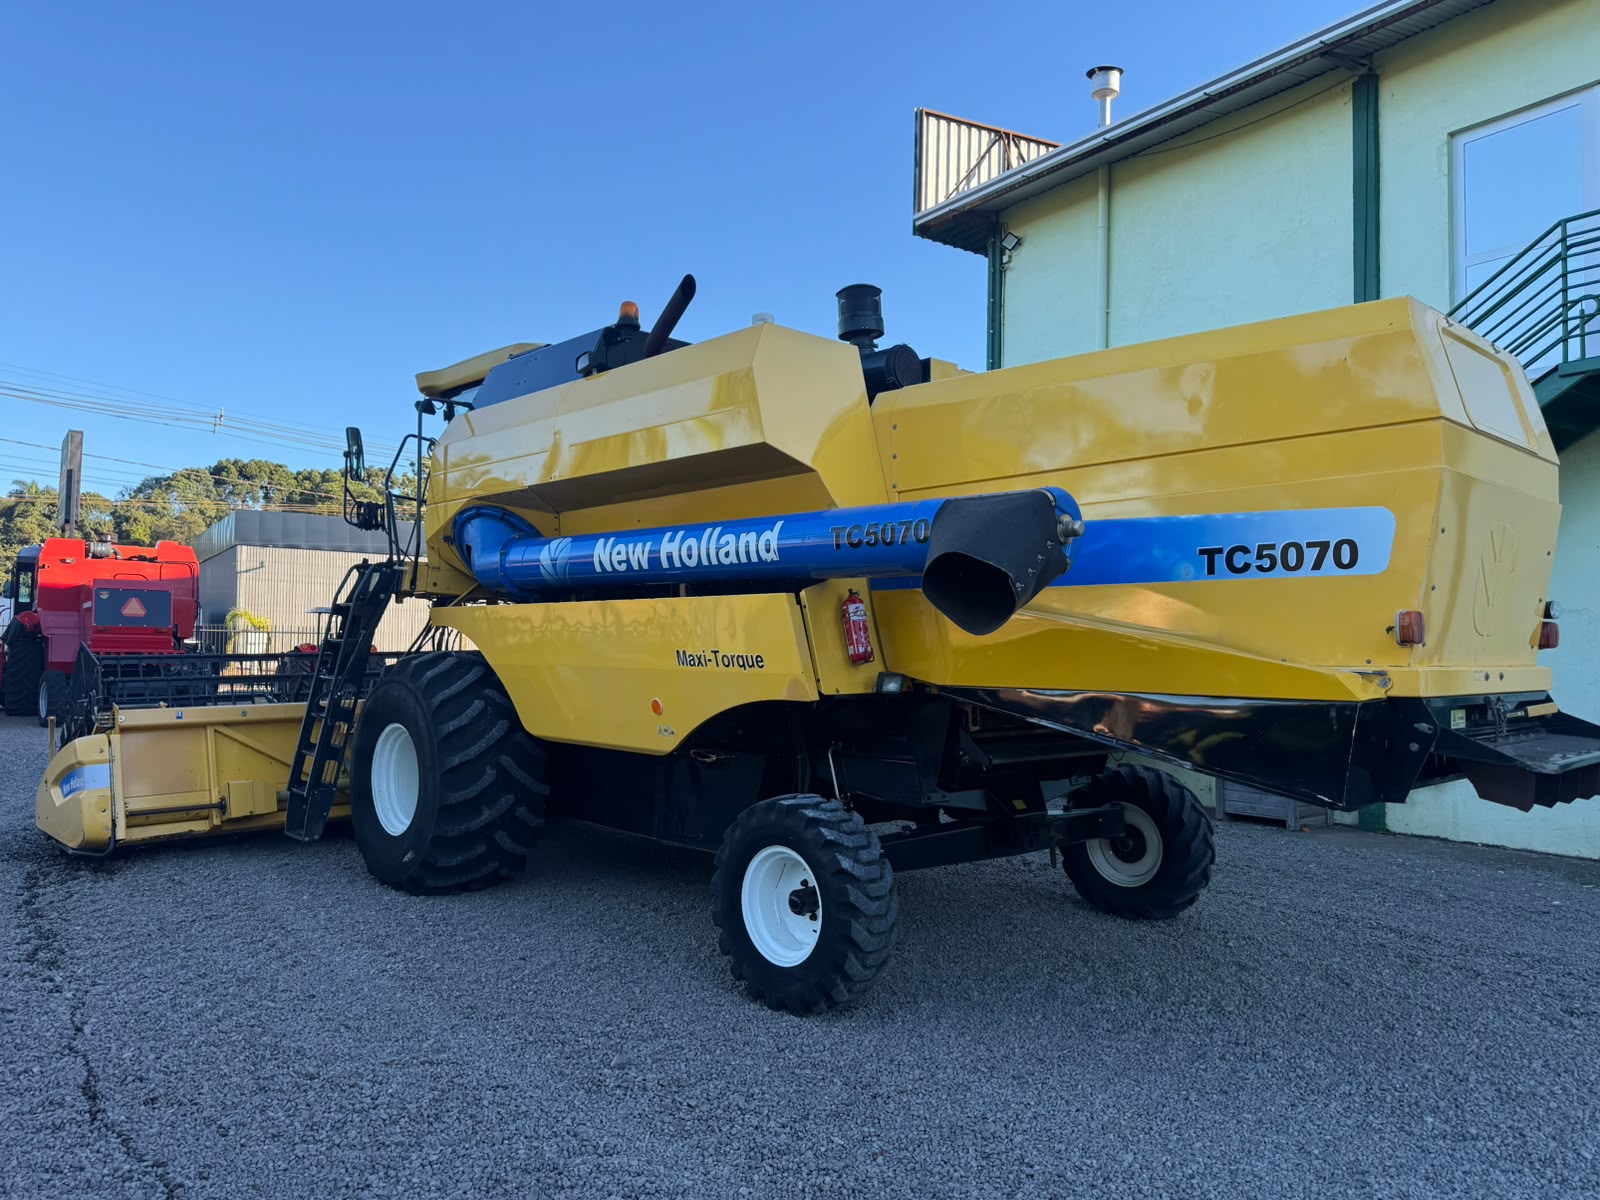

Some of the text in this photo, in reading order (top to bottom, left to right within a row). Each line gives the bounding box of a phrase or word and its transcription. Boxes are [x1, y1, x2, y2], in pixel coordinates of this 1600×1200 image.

[593, 520, 785, 573] New Holland
[829, 518, 930, 550] TC5070
[1197, 538, 1359, 576] TC5070
[676, 649, 765, 671] Maxi-Torque
